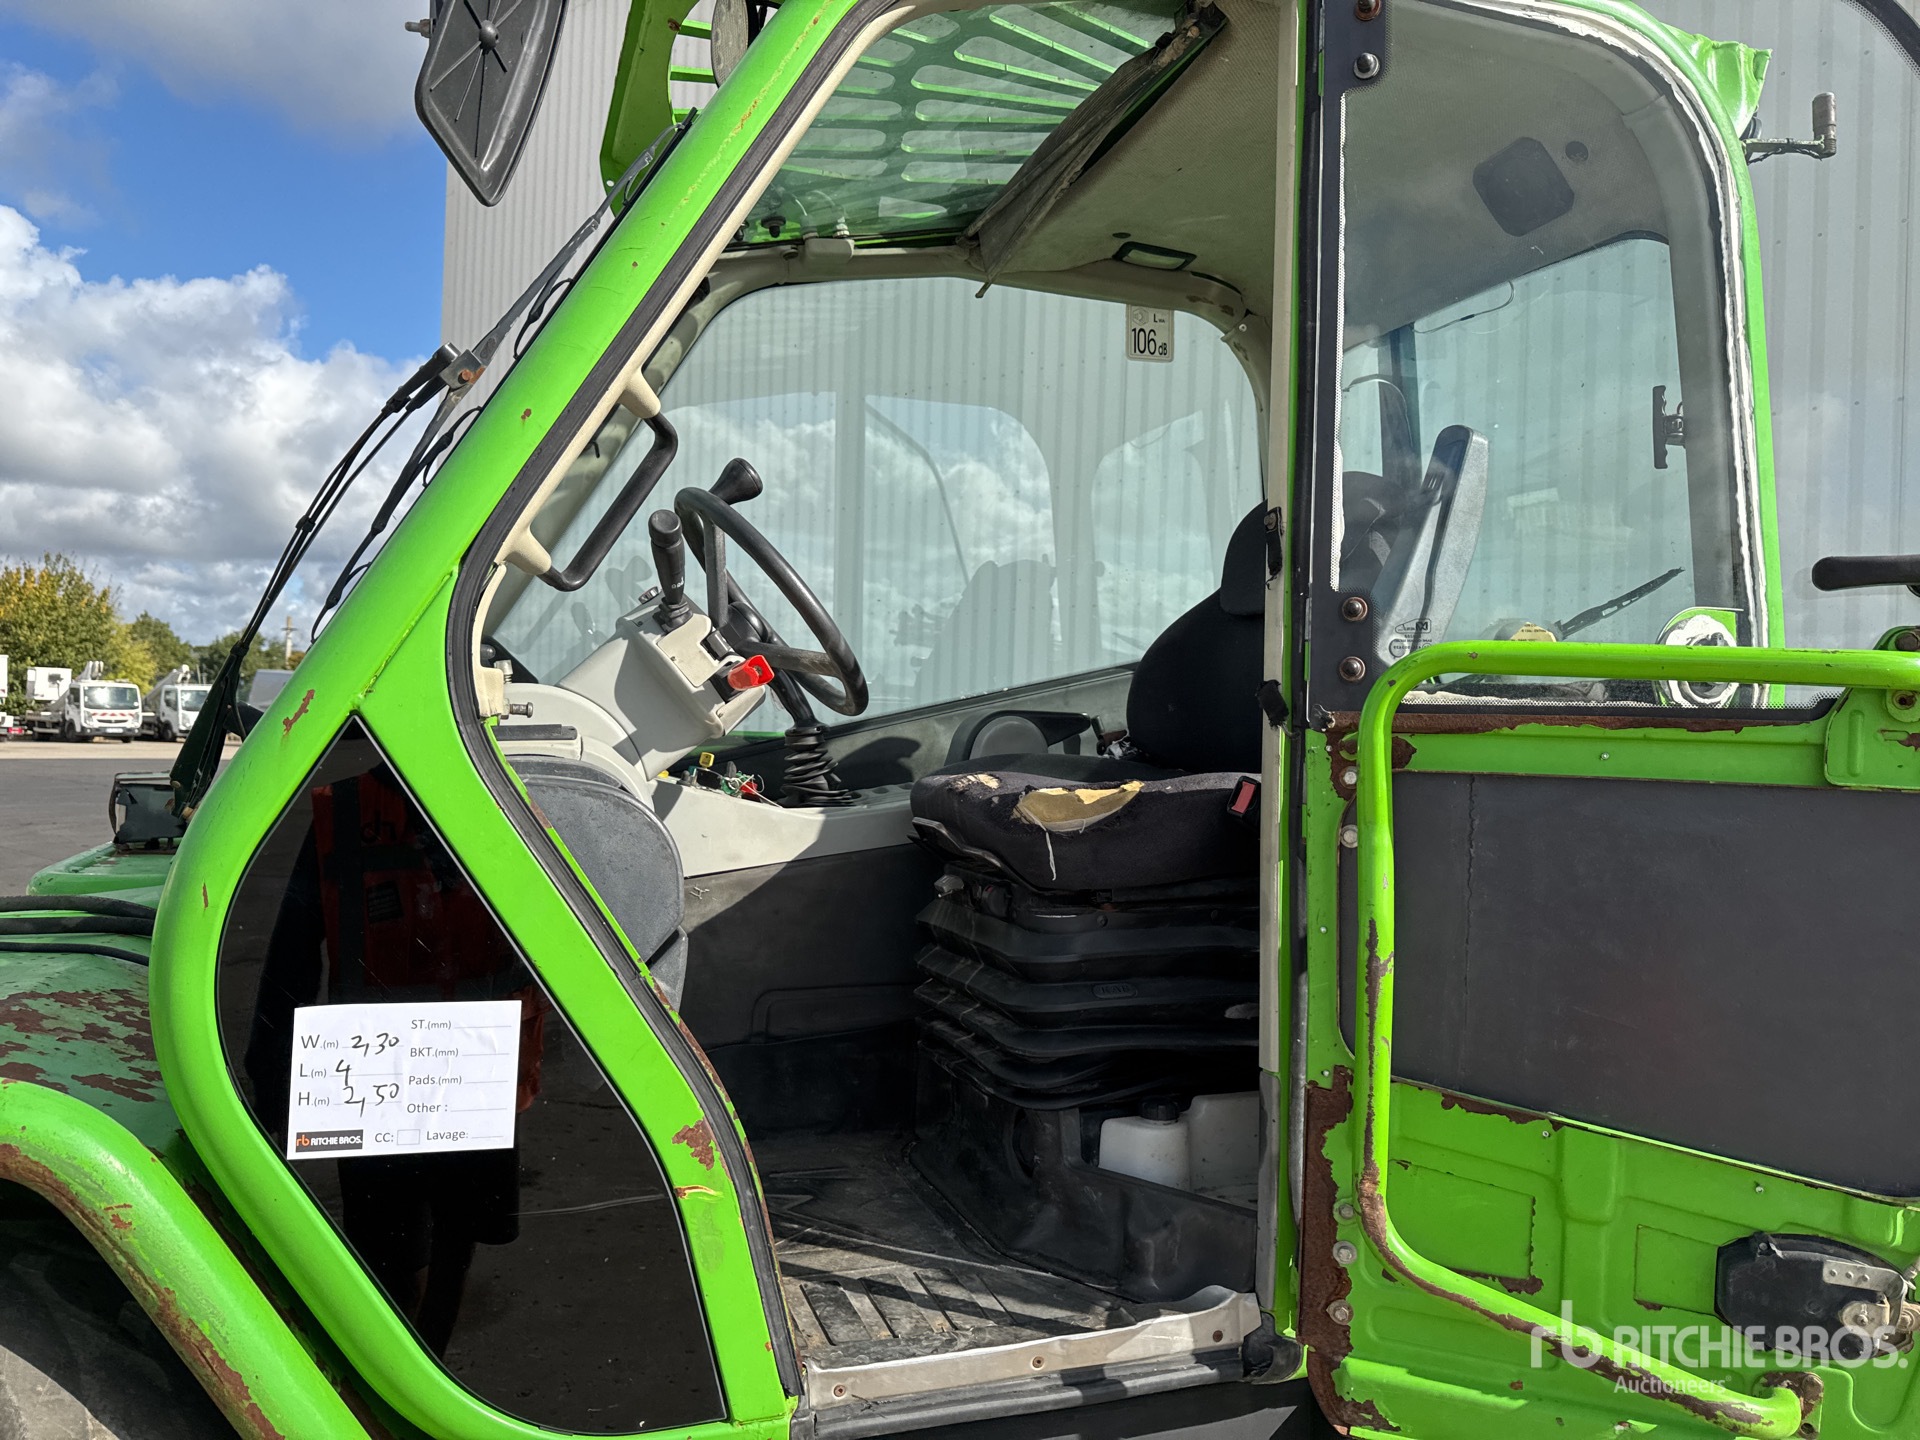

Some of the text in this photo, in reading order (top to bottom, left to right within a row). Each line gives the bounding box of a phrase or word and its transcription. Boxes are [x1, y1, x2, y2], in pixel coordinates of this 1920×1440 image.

[1131, 327, 1157, 356] 106
[350, 1032, 400, 1057] 2,30
[335, 1059, 352, 1087] 4
[341, 1082, 400, 1118] 2,50
[310, 1136, 339, 1147] RITCHIE
[339, 1135, 363, 1146] BROS.
